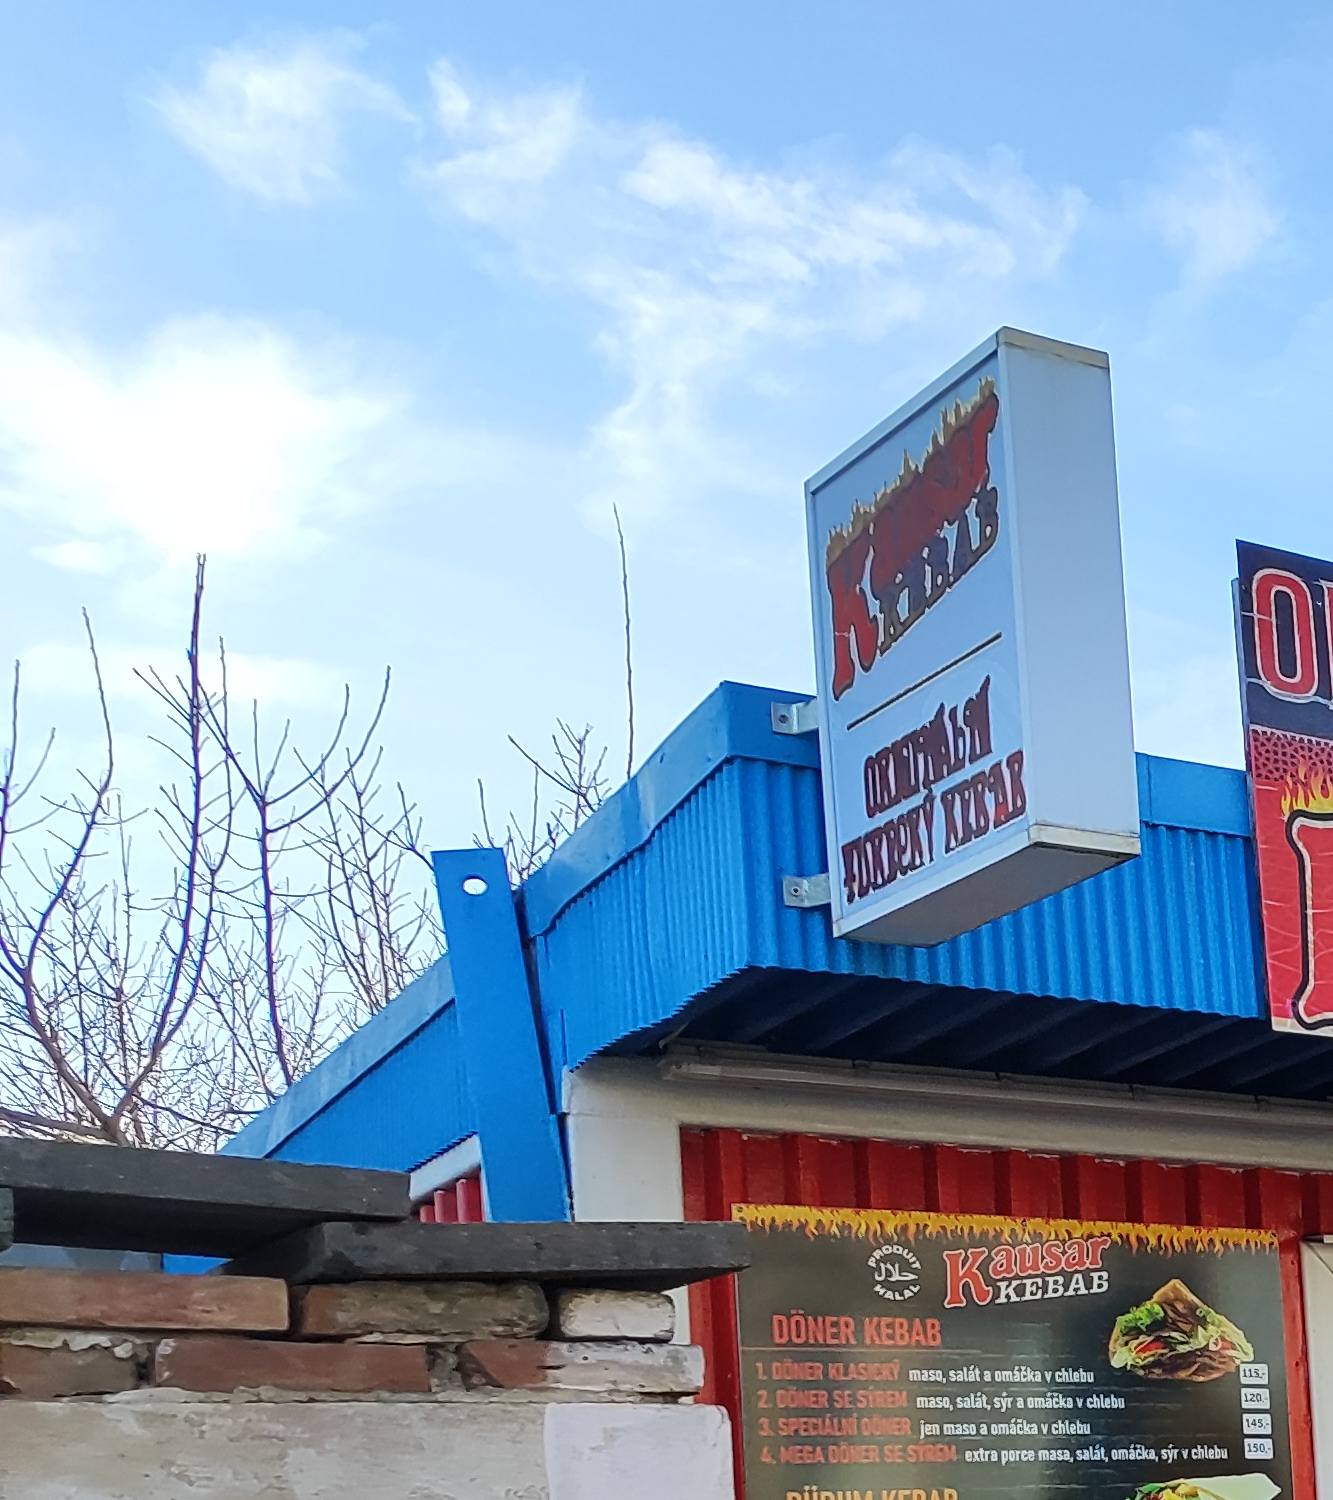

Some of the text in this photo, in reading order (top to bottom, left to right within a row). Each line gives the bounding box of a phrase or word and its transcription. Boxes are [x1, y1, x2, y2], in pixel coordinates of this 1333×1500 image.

[941, 748, 1028, 855] KEBAB
[867, 1244, 922, 1270] PRODUIT
[874, 1262, 919, 1281] حلال
[943, 1236, 1111, 1308] Kausar
[873, 1284, 921, 1301] HALAL
[995, 1272, 1110, 1306] KEBAB
[772, 1310, 941, 1348] DÖNER KEBAB
